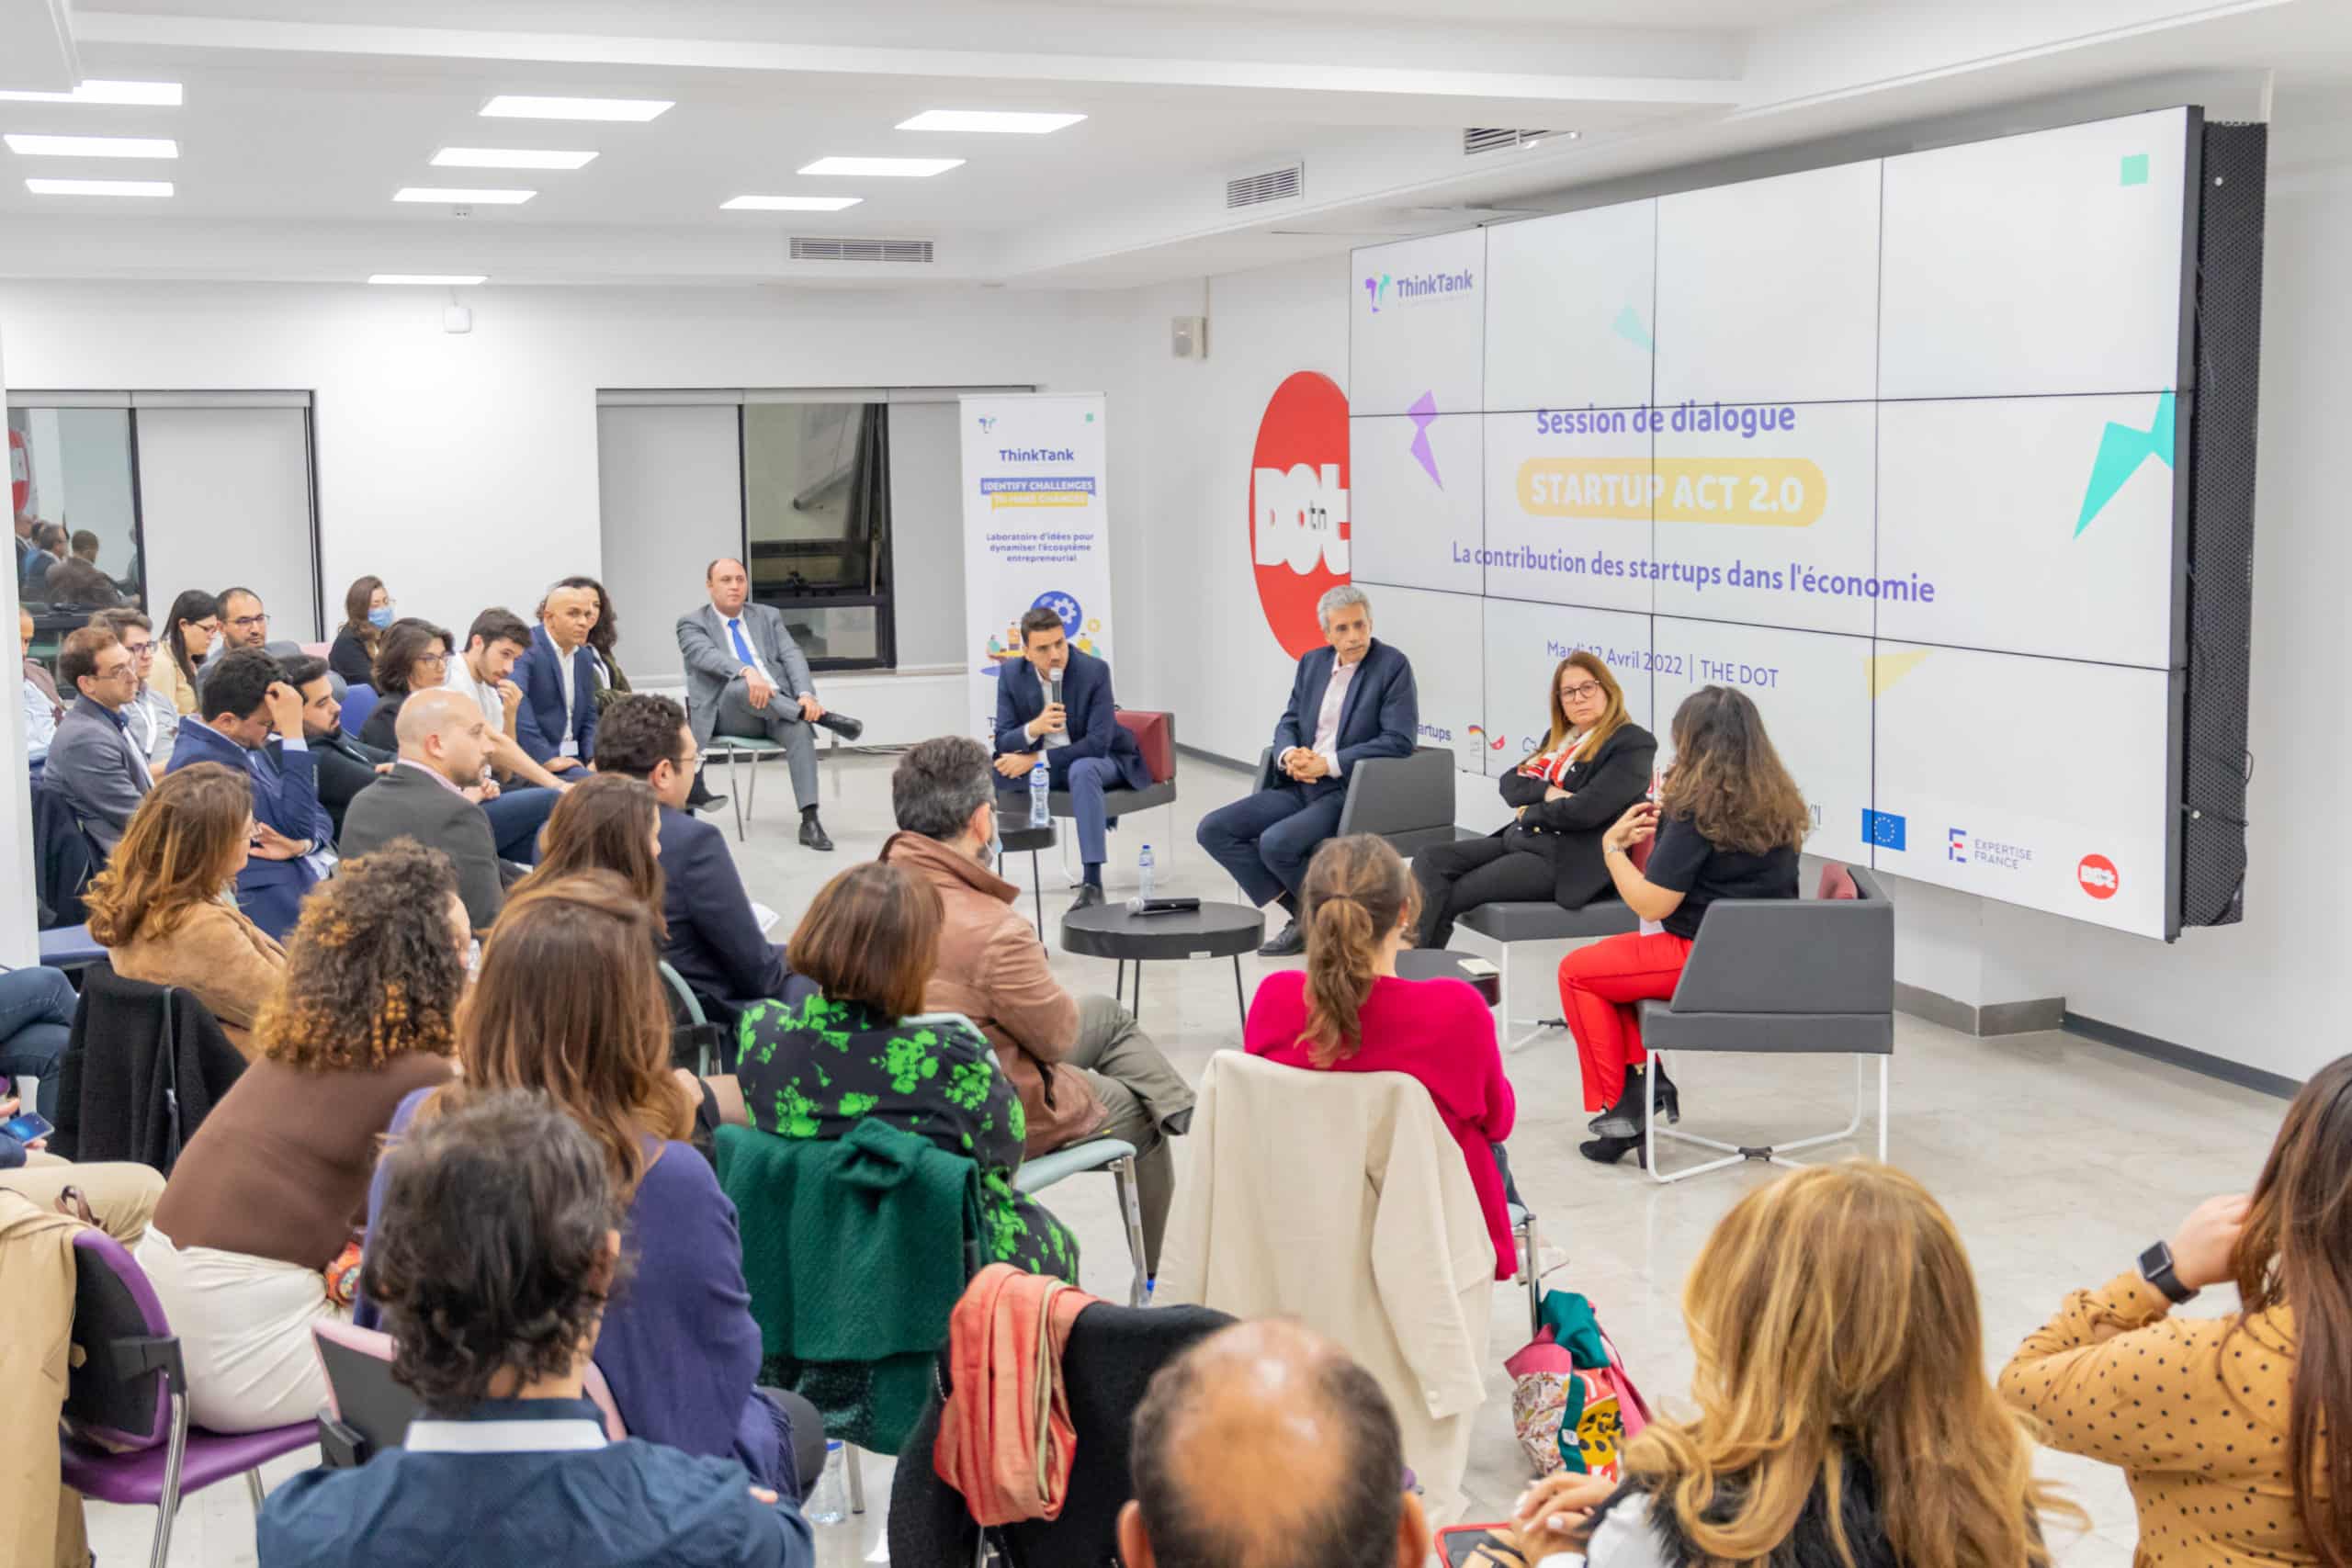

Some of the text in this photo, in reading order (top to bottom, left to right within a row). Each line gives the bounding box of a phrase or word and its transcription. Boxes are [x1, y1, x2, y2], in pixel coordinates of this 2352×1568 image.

[1396, 269, 1474, 299] ThinkTank
[1537, 400, 1795, 439] Session de dialogue
[999, 448, 1074, 461] ThinkTank
[983, 480, 1093, 491] IDENTIFY CHALLENGES
[1532, 473, 1804, 513] STARTUP ACT 2.0
[986, 533, 1037, 541] Laboratoire
[1073, 534, 1094, 543] pour
[989, 544, 1036, 553] dynamiser
[1006, 555, 1077, 564] entrepreneurial
[1453, 541, 1935, 603] La contribution des startups dans l'économie
[1607, 649, 1640, 669] Avril
[1643, 652, 1683, 675] 2022
[1701, 660, 1735, 682] THE
[1740, 665, 1780, 688] DOT
[1418, 724, 1452, 742] artups
[1974, 839, 2033, 861] EXPERTISE
[1974, 851, 2019, 870] FRANCE
